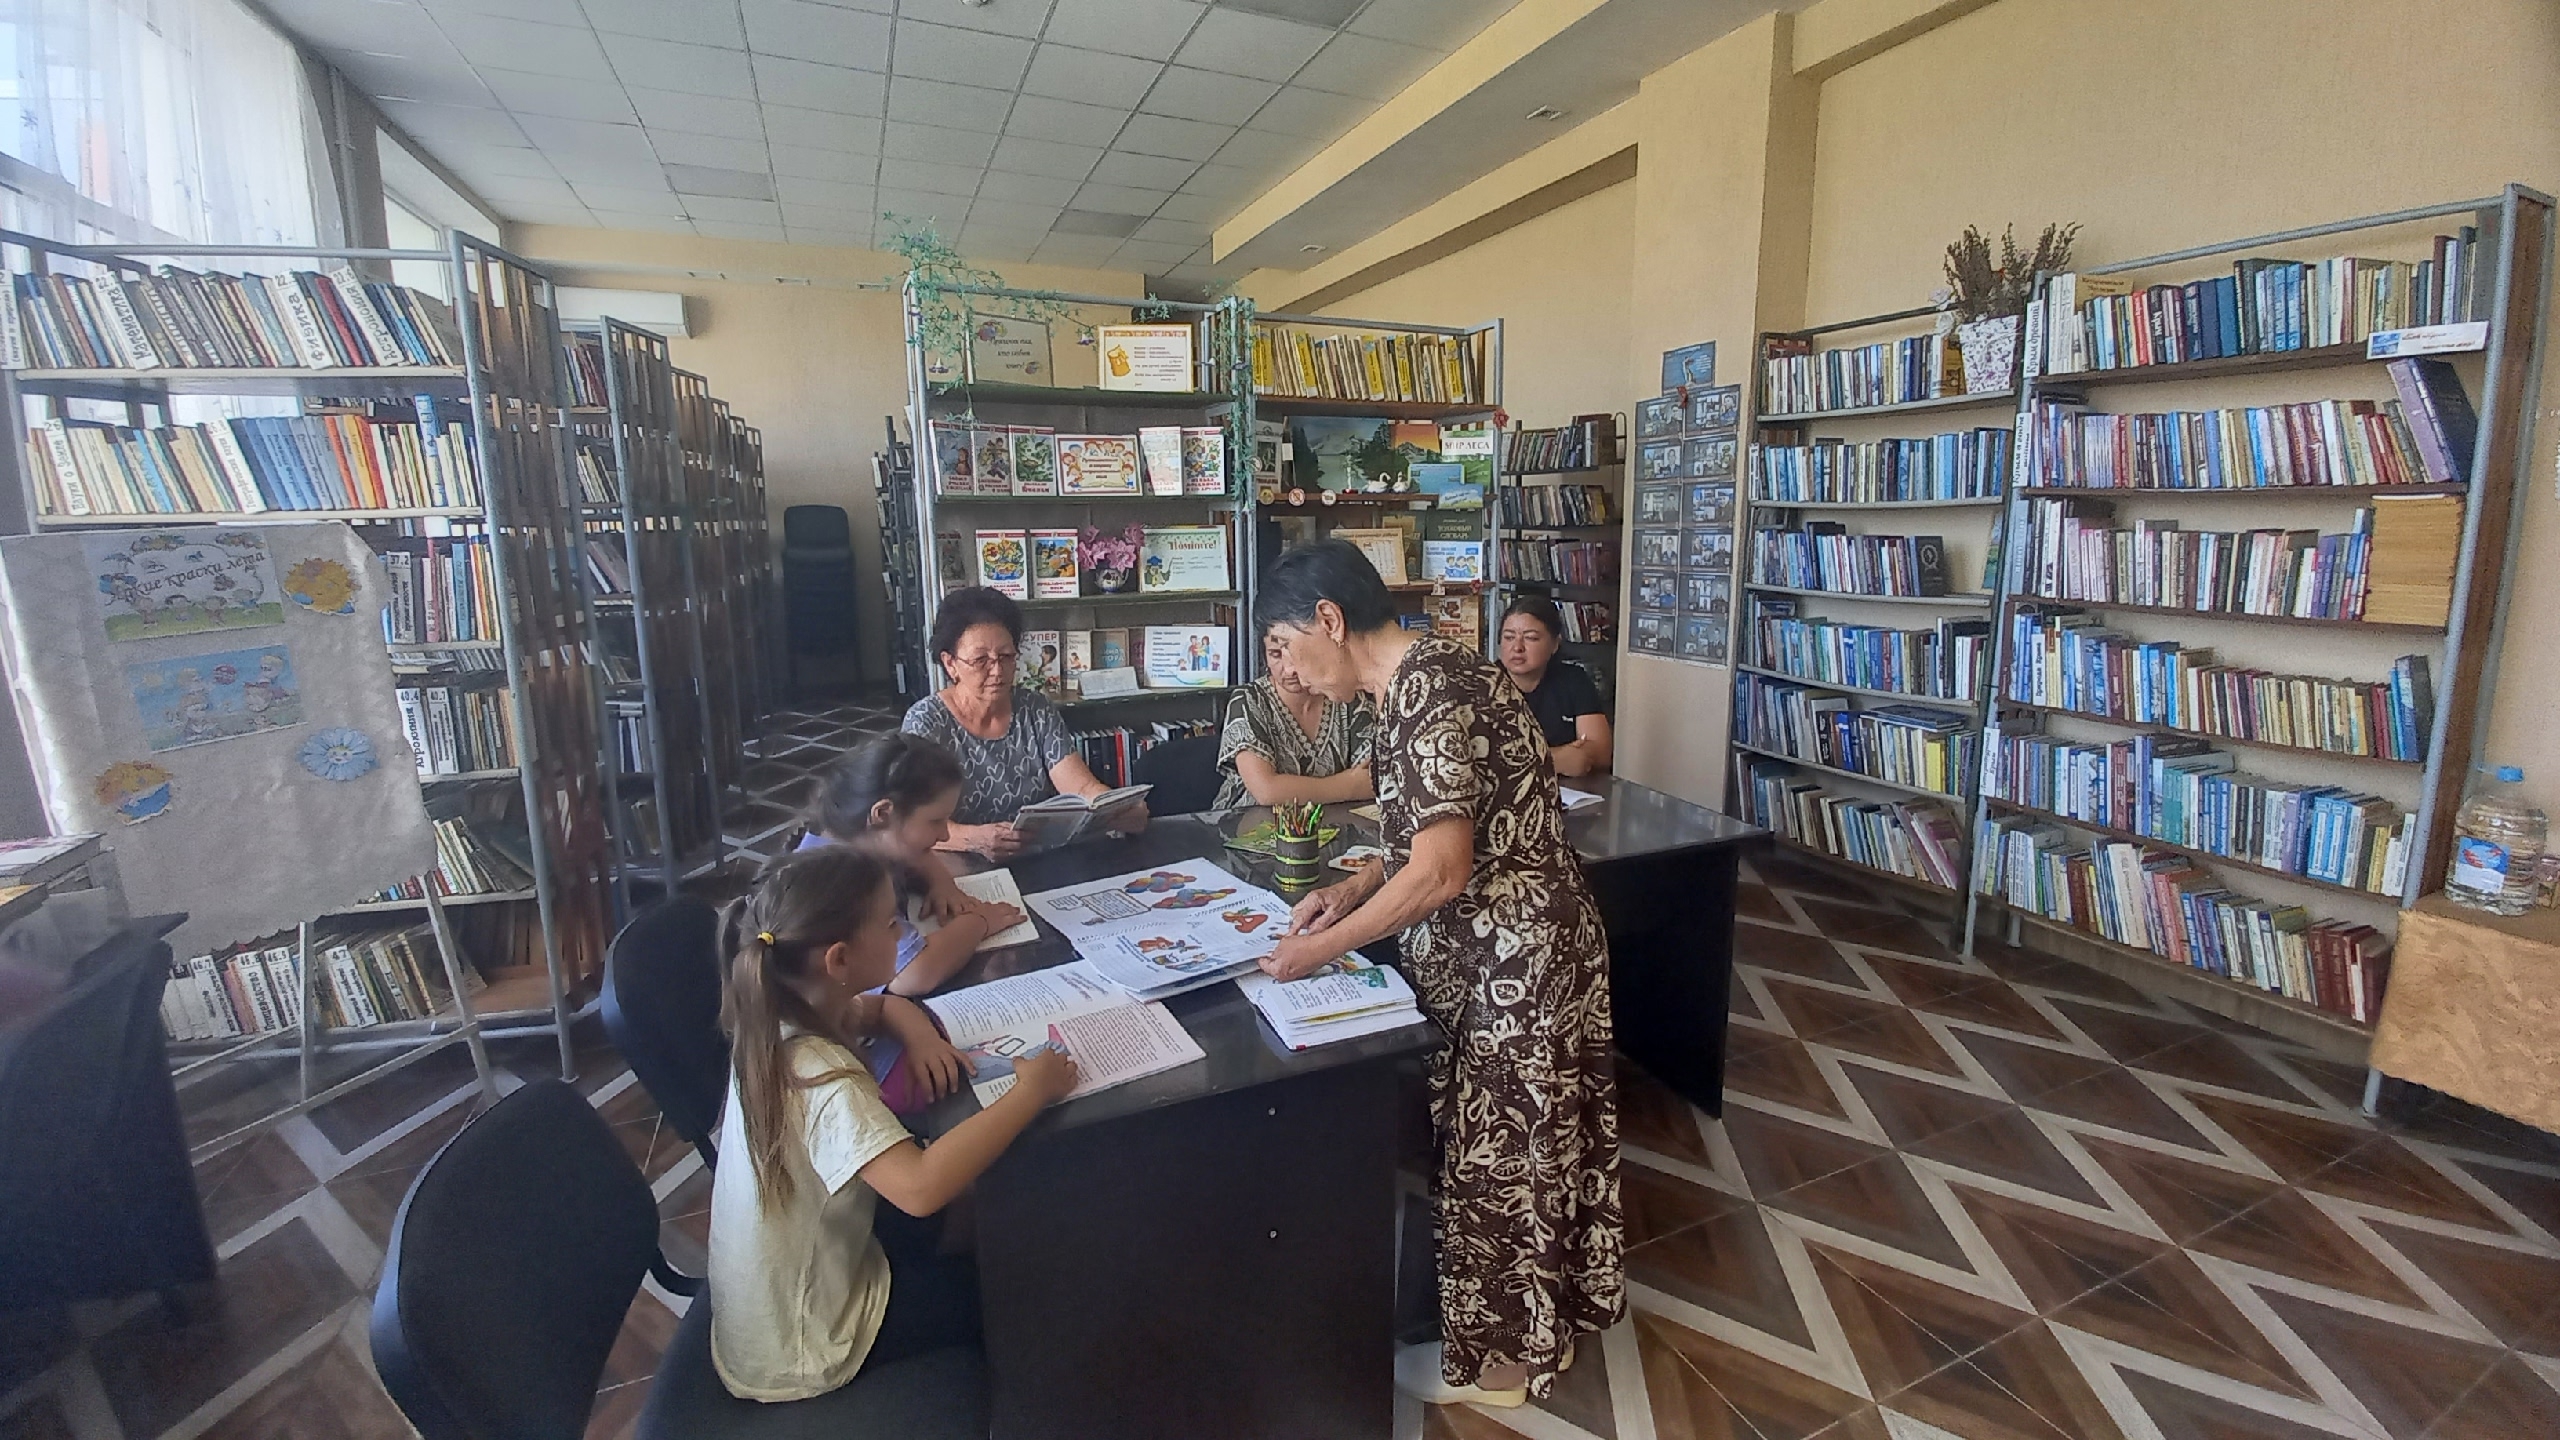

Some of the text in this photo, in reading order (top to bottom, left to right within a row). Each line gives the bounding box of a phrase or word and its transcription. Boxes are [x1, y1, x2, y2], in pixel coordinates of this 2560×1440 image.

[108, 287, 152, 360] Математика
[288, 292, 325, 362] Физика
[346, 284, 399, 362] Астрономия
[2026, 304, 2040, 374] Крым древний
[163, 562, 223, 587] краски
[226, 551, 265, 570] лета
[1022, 633, 1057, 641] СУПЕР
